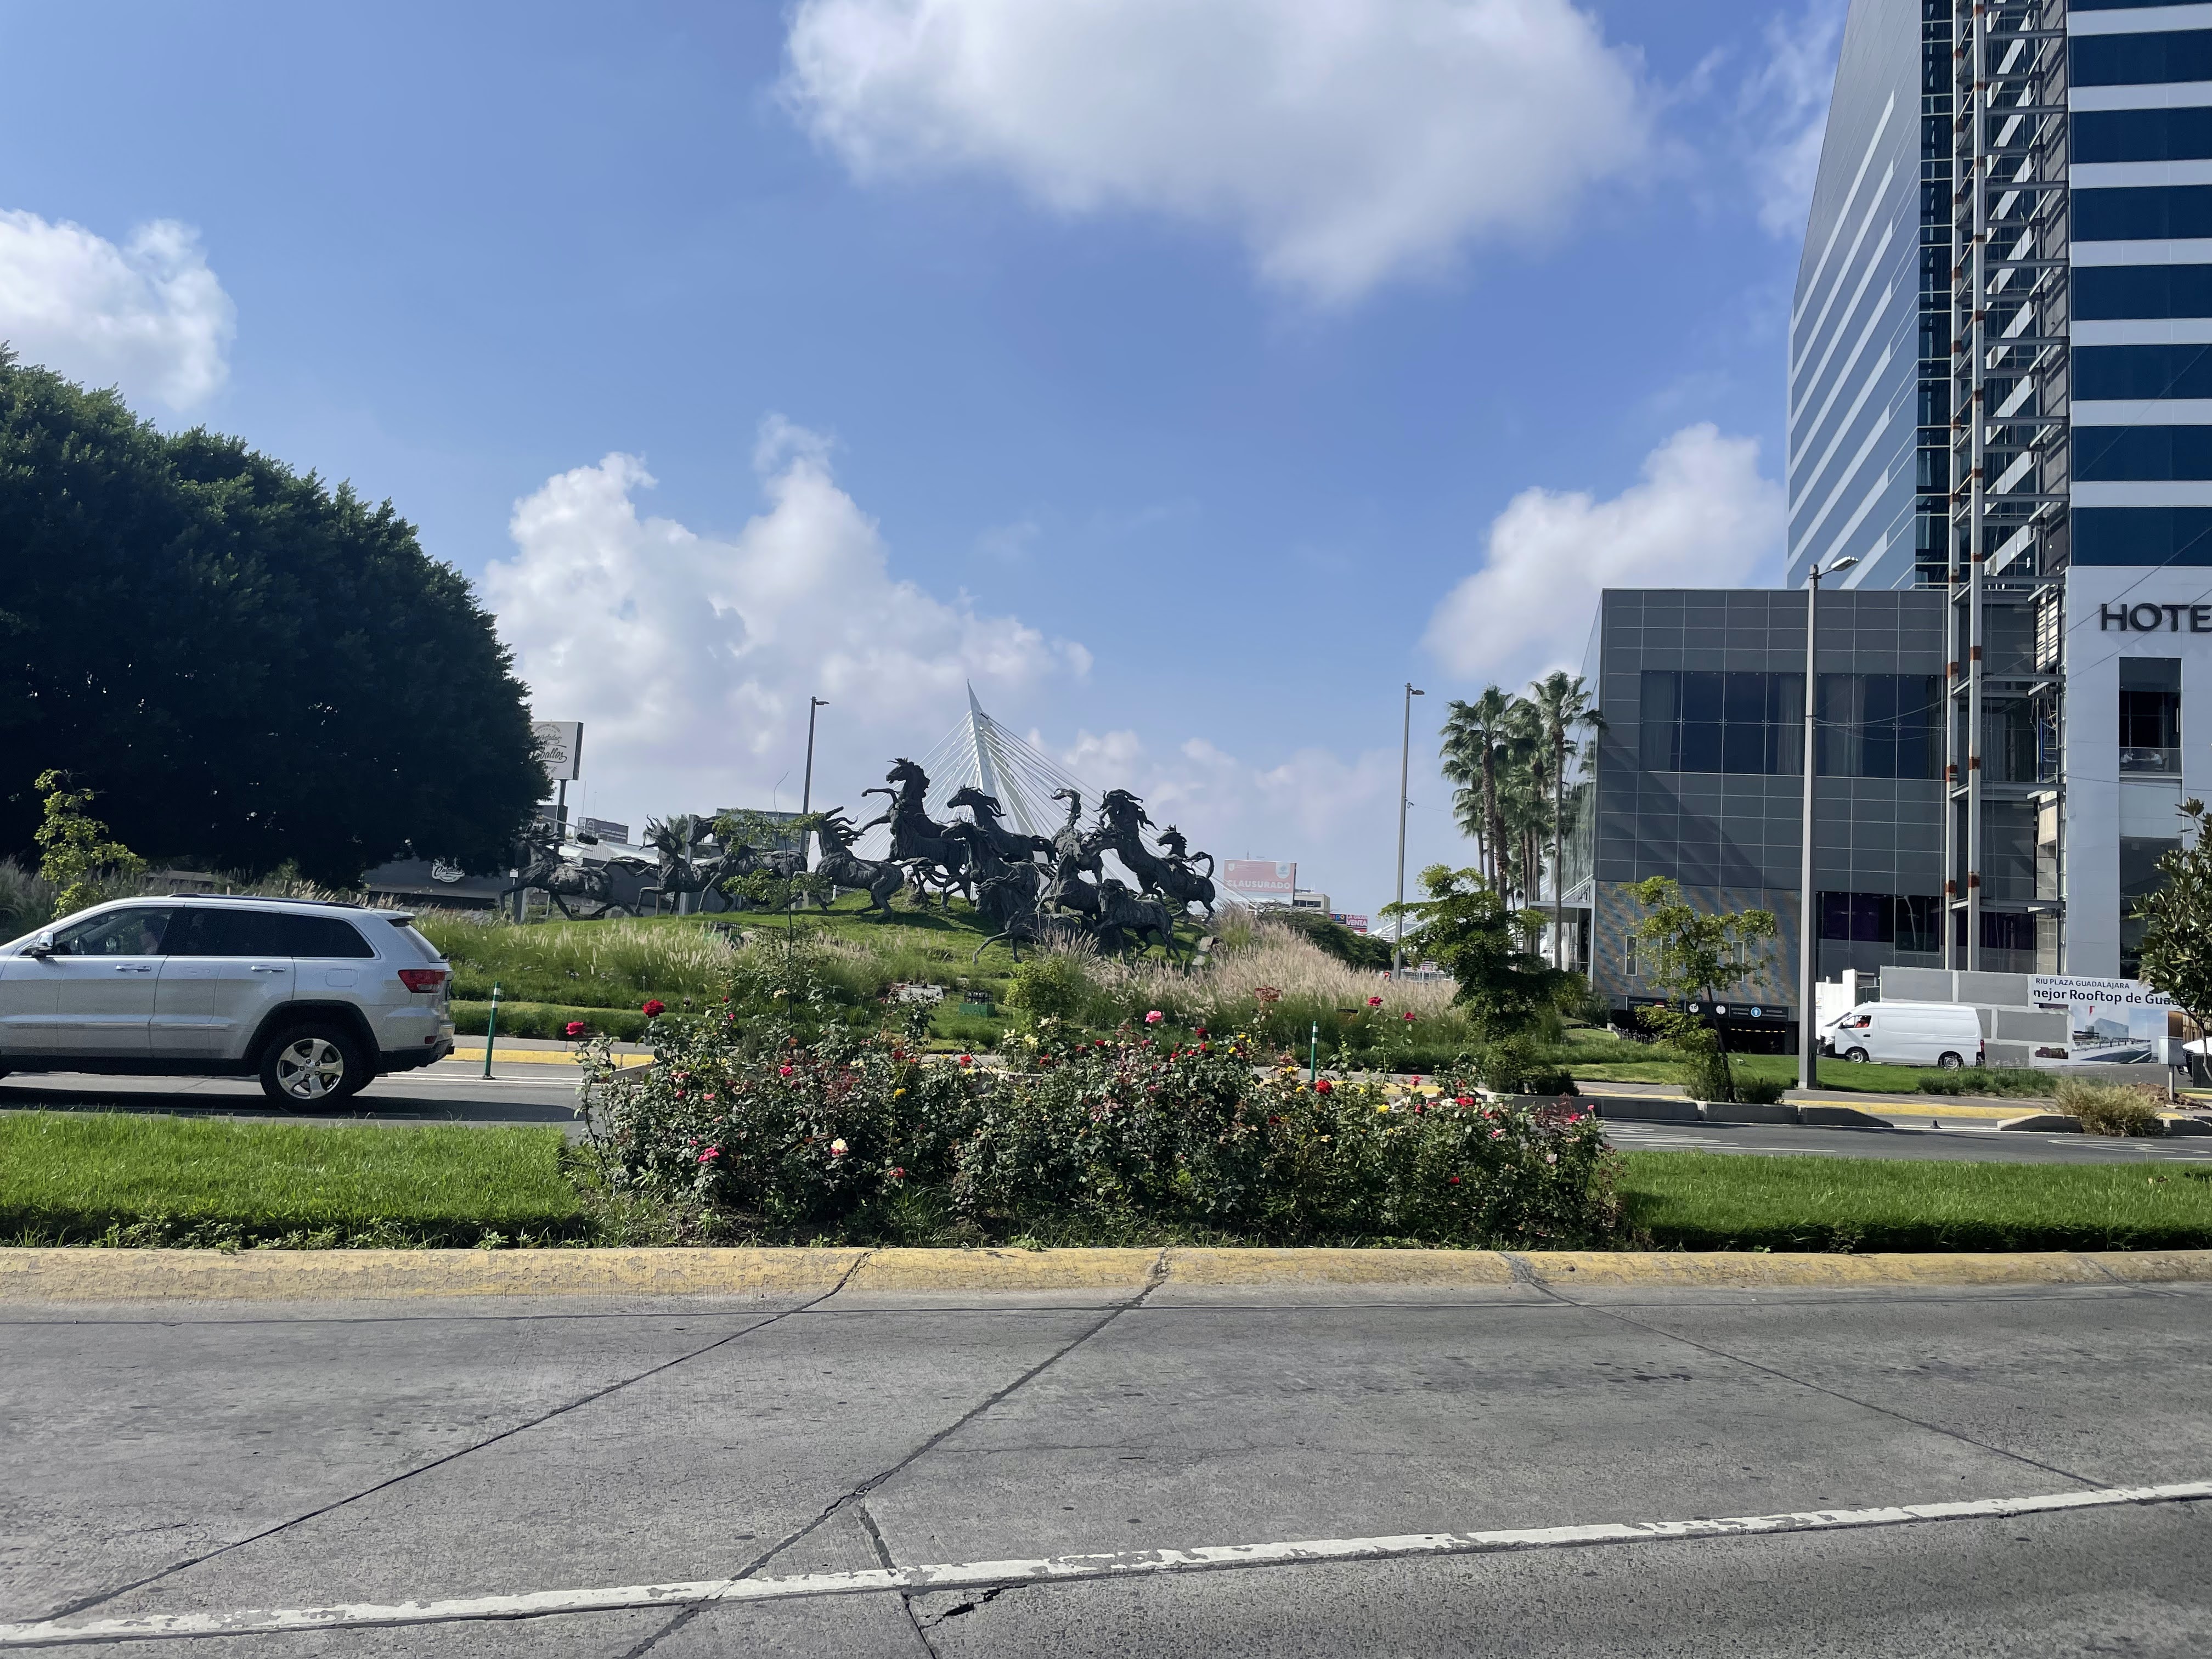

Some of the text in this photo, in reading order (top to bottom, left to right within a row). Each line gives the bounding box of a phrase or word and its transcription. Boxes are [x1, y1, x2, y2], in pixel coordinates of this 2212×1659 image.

[2101, 603, 2212, 632] HOTE
[1227, 879, 1290, 889] CLAUSURADO
[2076, 980, 2130, 989] GUADALAJARA
[2070, 989, 2122, 1005] Rooftop
[2125, 992, 2142, 1004] de
